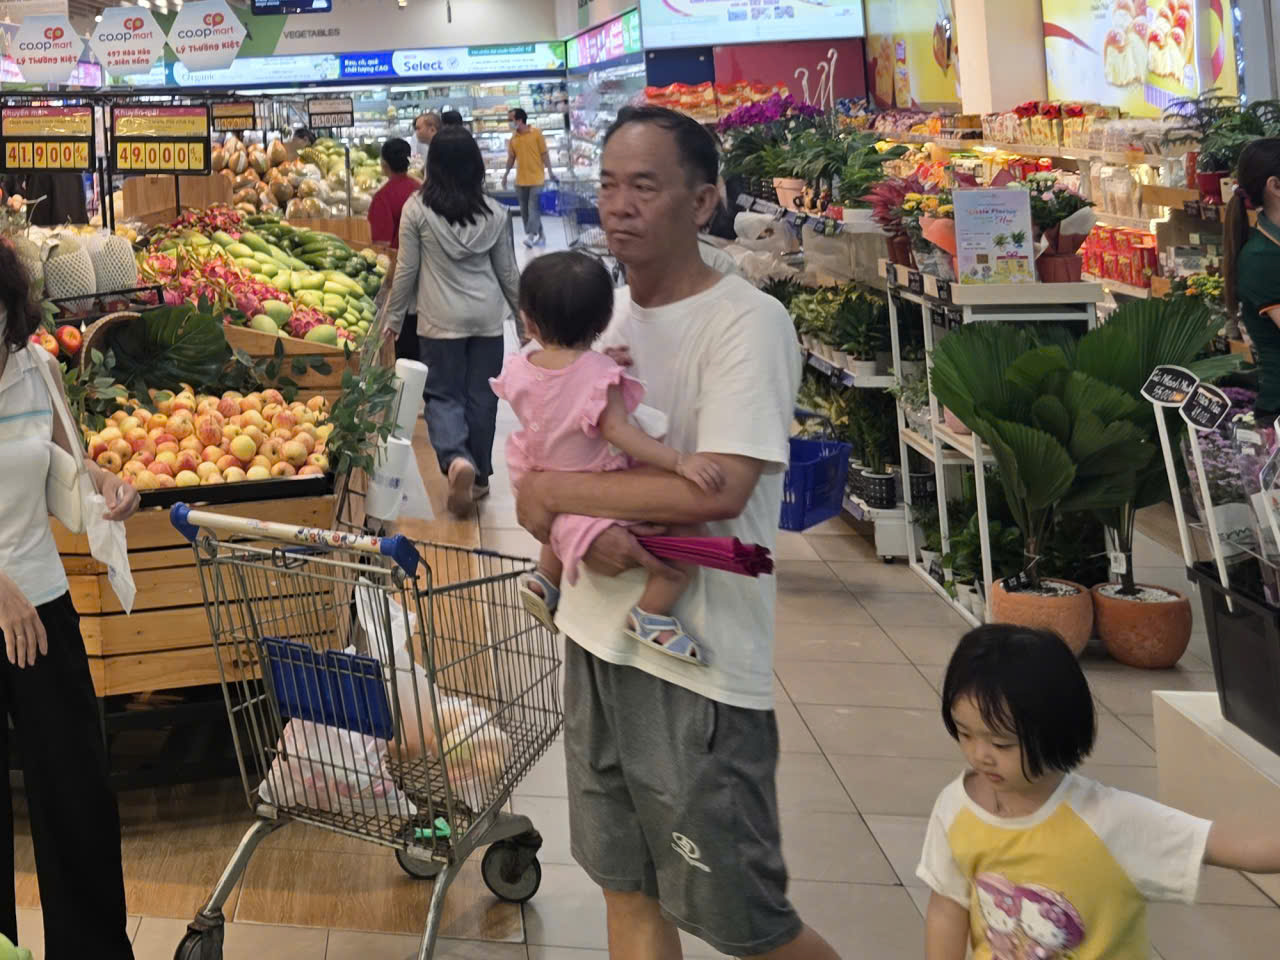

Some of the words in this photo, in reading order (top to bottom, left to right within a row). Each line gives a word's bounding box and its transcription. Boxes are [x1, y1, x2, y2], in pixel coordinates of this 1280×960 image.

[283, 28, 340, 39] VEGETABLES
[176, 46, 186, 55] Lý
[189, 41, 219, 52] Thường
[16, 56, 26, 66] Lý
[28, 54, 58, 65] Thường
[404, 60, 443, 72] Select
[375, 64, 389, 72] CAO
[8, 146, 72, 163] 41.900
[120, 147, 186, 163] 49.000
